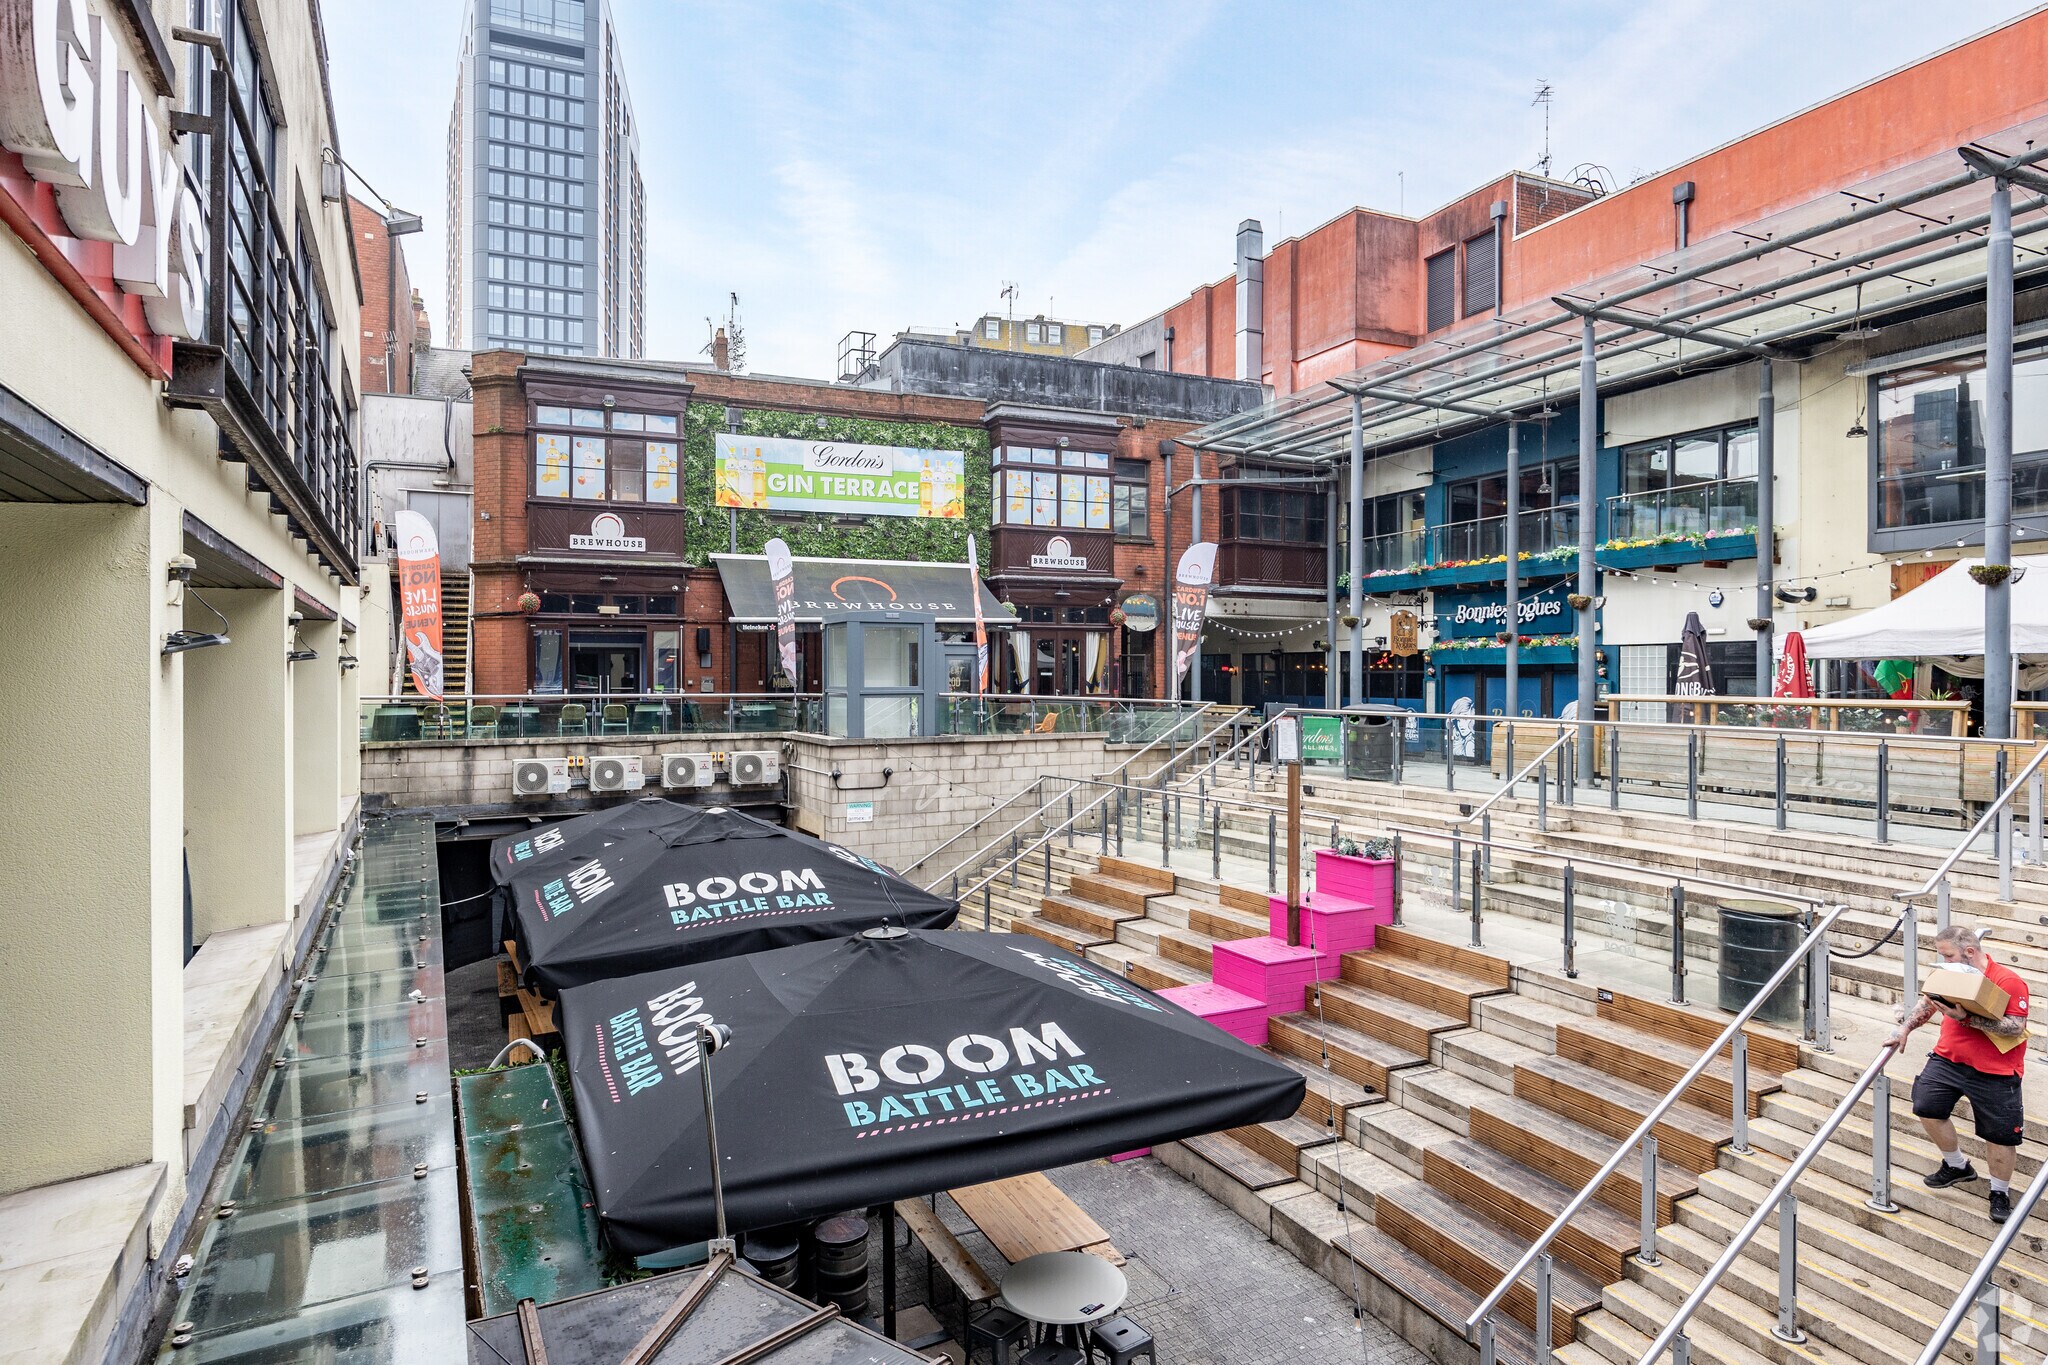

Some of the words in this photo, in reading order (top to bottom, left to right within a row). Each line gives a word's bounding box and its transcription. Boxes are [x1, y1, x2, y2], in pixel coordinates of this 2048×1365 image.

[30, 0, 205, 341] GUYS
[812, 444, 885, 470] Gordon's
[767, 473, 814, 495] GIN
[819, 475, 920, 500] TERRACE
[572, 538, 643, 548] BREWHOUSE
[1033, 557, 1085, 567] BREWHOUSE
[1177, 592, 1206, 607] NO.1
[1455, 602, 1501, 624] Bonnie
[1516, 600, 1561, 623] ogues
[1782, 652, 1795, 685] RETTI
[662, 868, 826, 908] BOOM
[548, 894, 575, 918] BAR
[670, 896, 770, 925] BATTLE
[775, 892, 834, 909] BAR
[647, 980, 731, 1075] BOOM
[620, 1052, 664, 1097] BAR
[824, 1021, 1086, 1096] BOOM
[842, 1078, 1006, 1128] BATTLE
[1011, 1063, 1107, 1098] BAR
